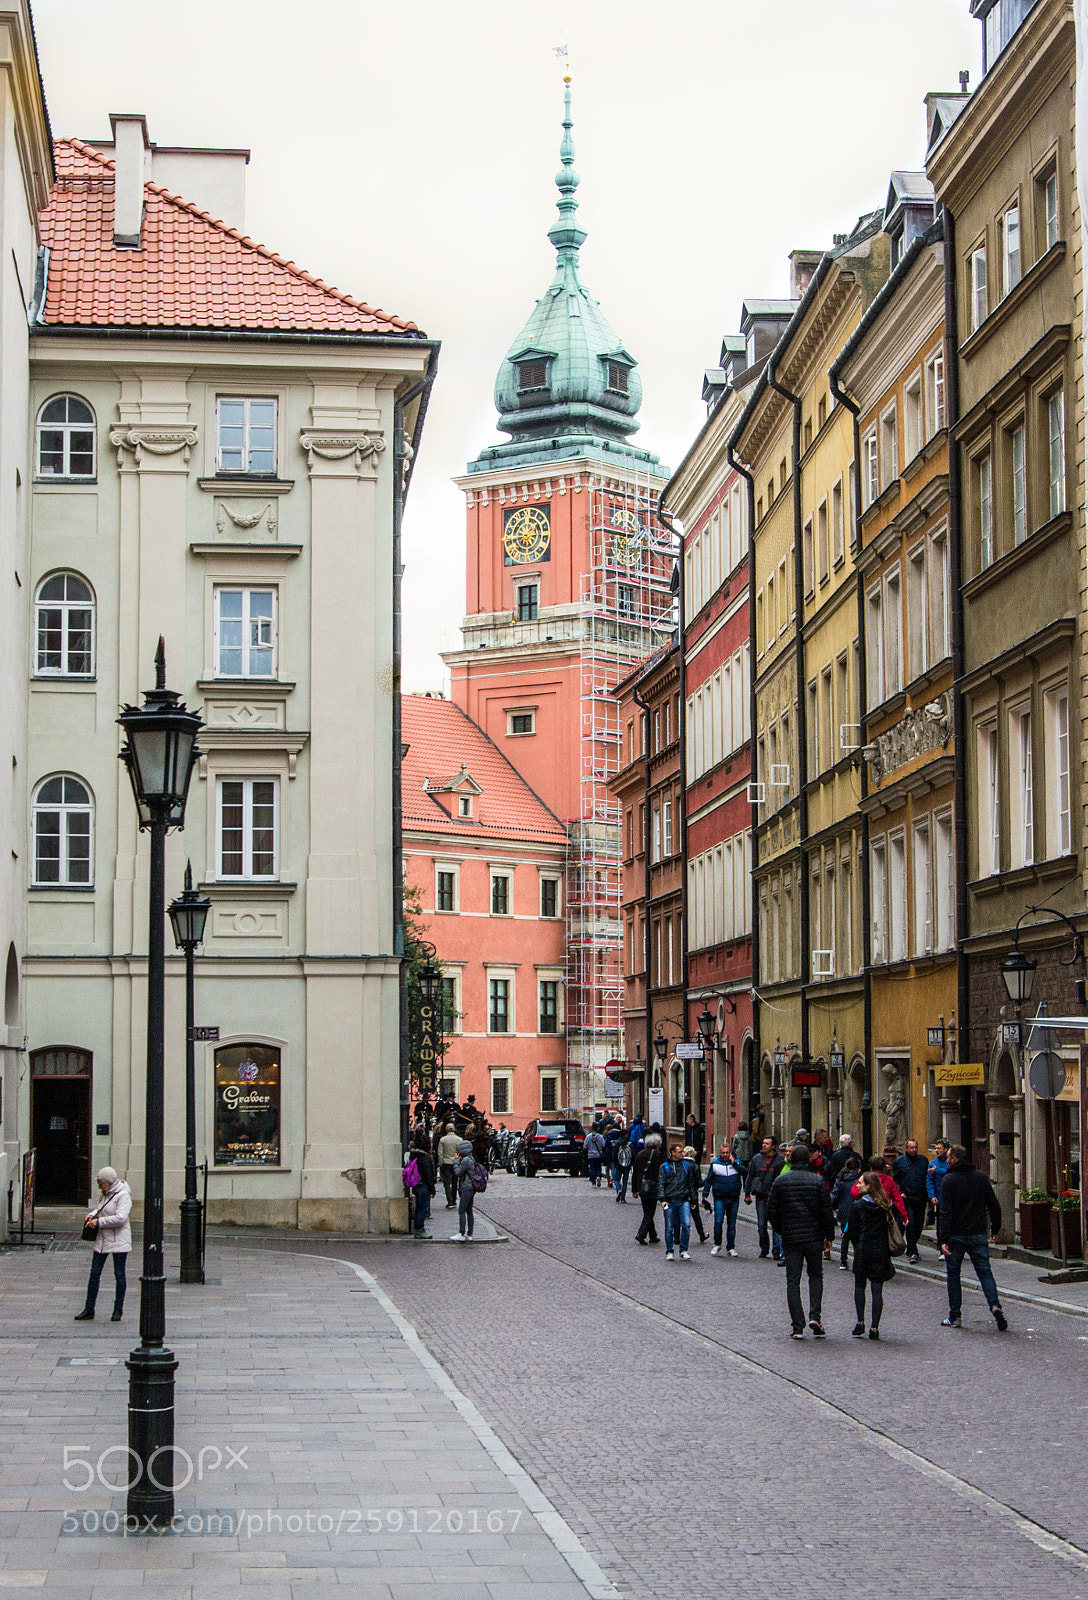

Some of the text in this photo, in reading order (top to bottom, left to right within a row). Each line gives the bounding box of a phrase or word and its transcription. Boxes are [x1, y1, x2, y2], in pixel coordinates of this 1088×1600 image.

[932, 1030, 939, 1038] 11
[1007, 1025, 1017, 1035] 13
[420, 1006, 434, 1089] GRAWER
[222, 1085, 271, 1110] Grawer
